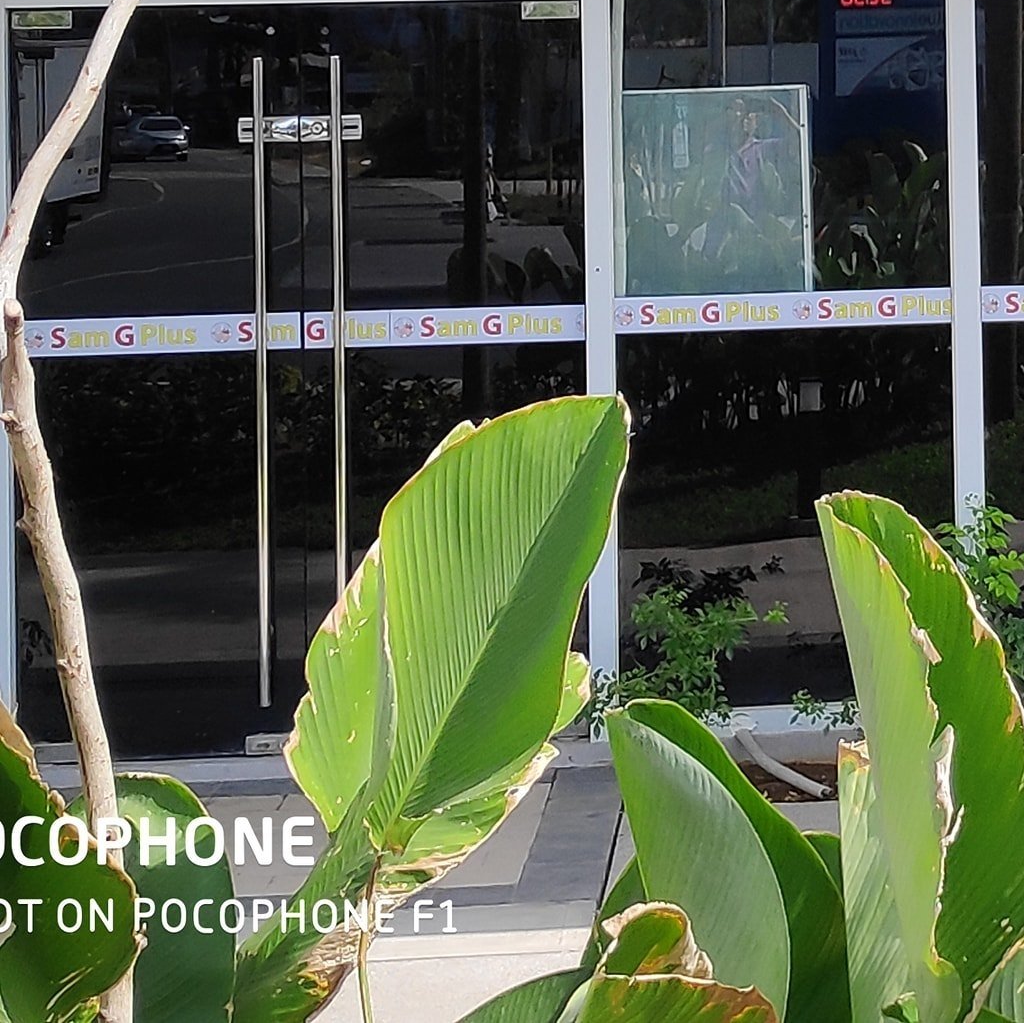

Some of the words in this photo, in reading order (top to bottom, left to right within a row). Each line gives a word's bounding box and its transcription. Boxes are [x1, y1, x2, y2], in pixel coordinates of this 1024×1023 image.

[640, 304, 696, 325] Sam
[725, 300, 780, 323] Plus
[818, 298, 873, 319] Sam
[51, 327, 110, 348] Sam
[141, 324, 198, 348] Plus
[238, 321, 296, 343] Sm
[420, 316, 477, 337] Sam
[507, 313, 562, 335] Plus
